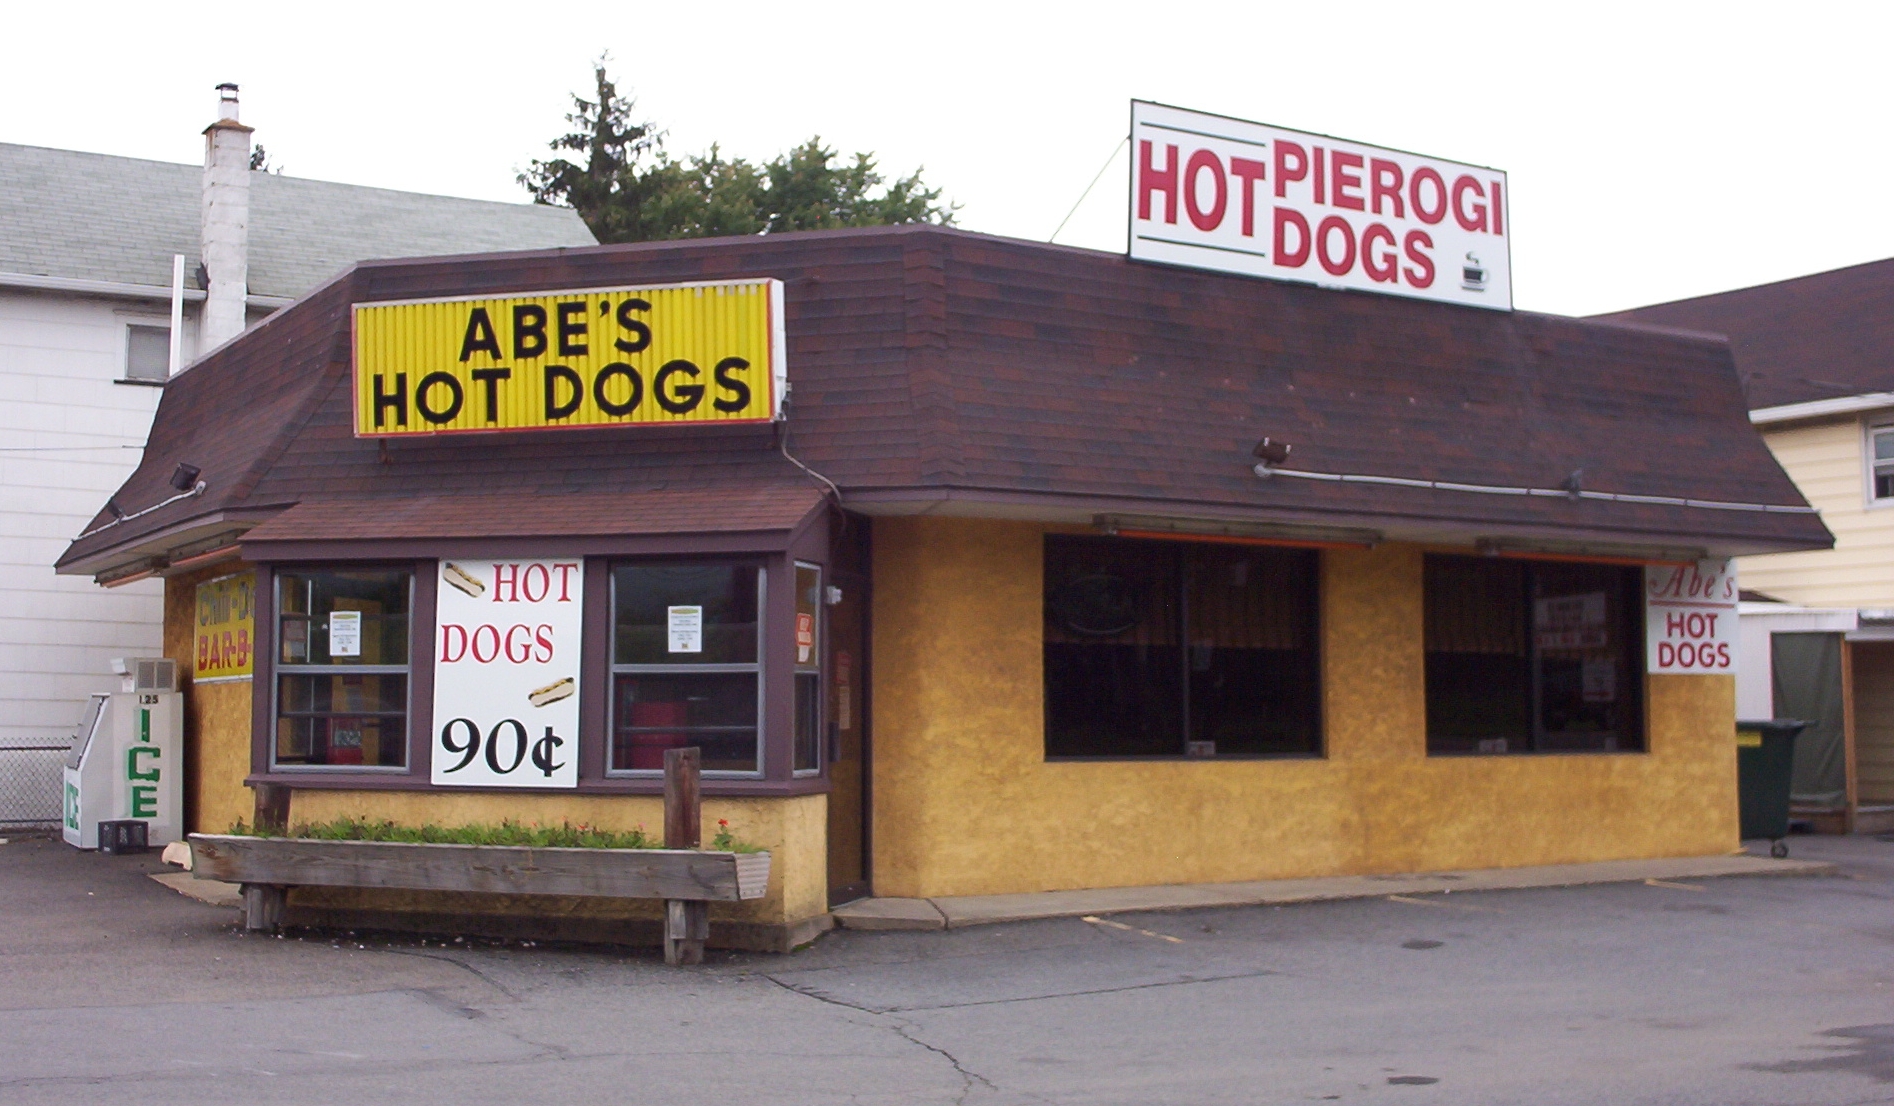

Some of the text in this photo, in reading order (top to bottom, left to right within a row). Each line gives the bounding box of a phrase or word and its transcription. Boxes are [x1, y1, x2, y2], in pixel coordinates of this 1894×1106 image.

[1137, 138, 1266, 238] HOT
[1273, 138, 1504, 237] PIEROGI
[1272, 205, 1436, 290] DOGS
[458, 298, 653, 363] ABE'S
[372, 355, 752, 428] HOT DOGS
[492, 562, 579, 603] HOT
[1648, 563, 1735, 600] Abe's
[440, 623, 554, 664] DOGS
[1658, 640, 1731, 669] DOGS
[1666, 611, 1719, 639] HOT
[139, 694, 160, 705] 1.25
[128, 708, 161, 818] ICE
[440, 717, 567, 778] 90¢
